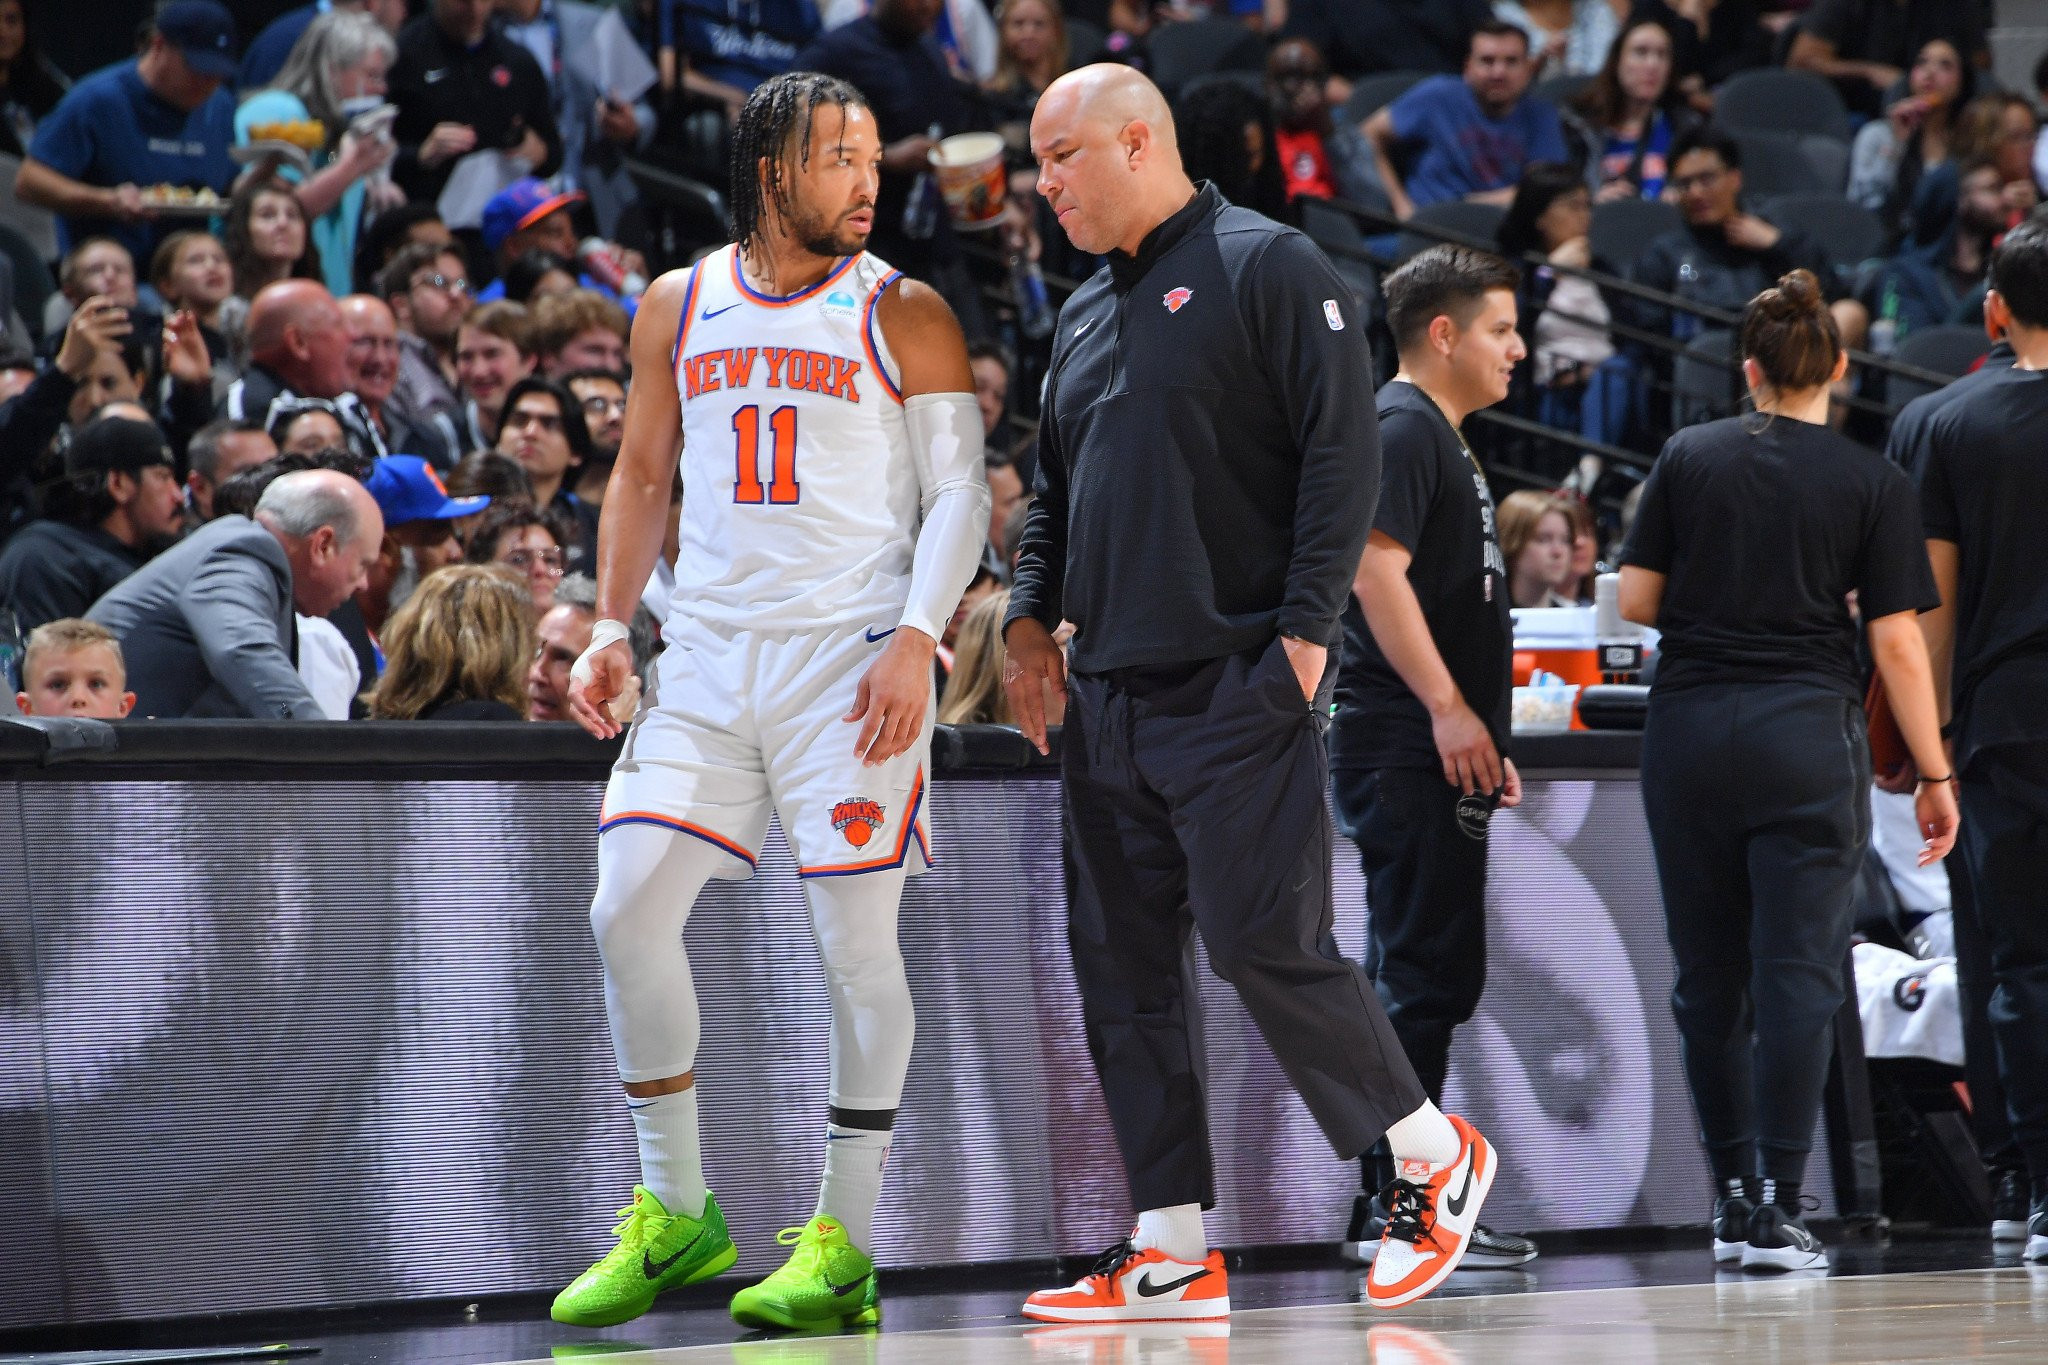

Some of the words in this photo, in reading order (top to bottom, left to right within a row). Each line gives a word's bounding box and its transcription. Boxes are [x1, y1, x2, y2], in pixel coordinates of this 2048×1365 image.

[684, 347, 757, 400] NEW
[762, 347, 860, 403] YORK
[731, 404, 800, 504] 11
[831, 800, 885, 825] KNICKS
